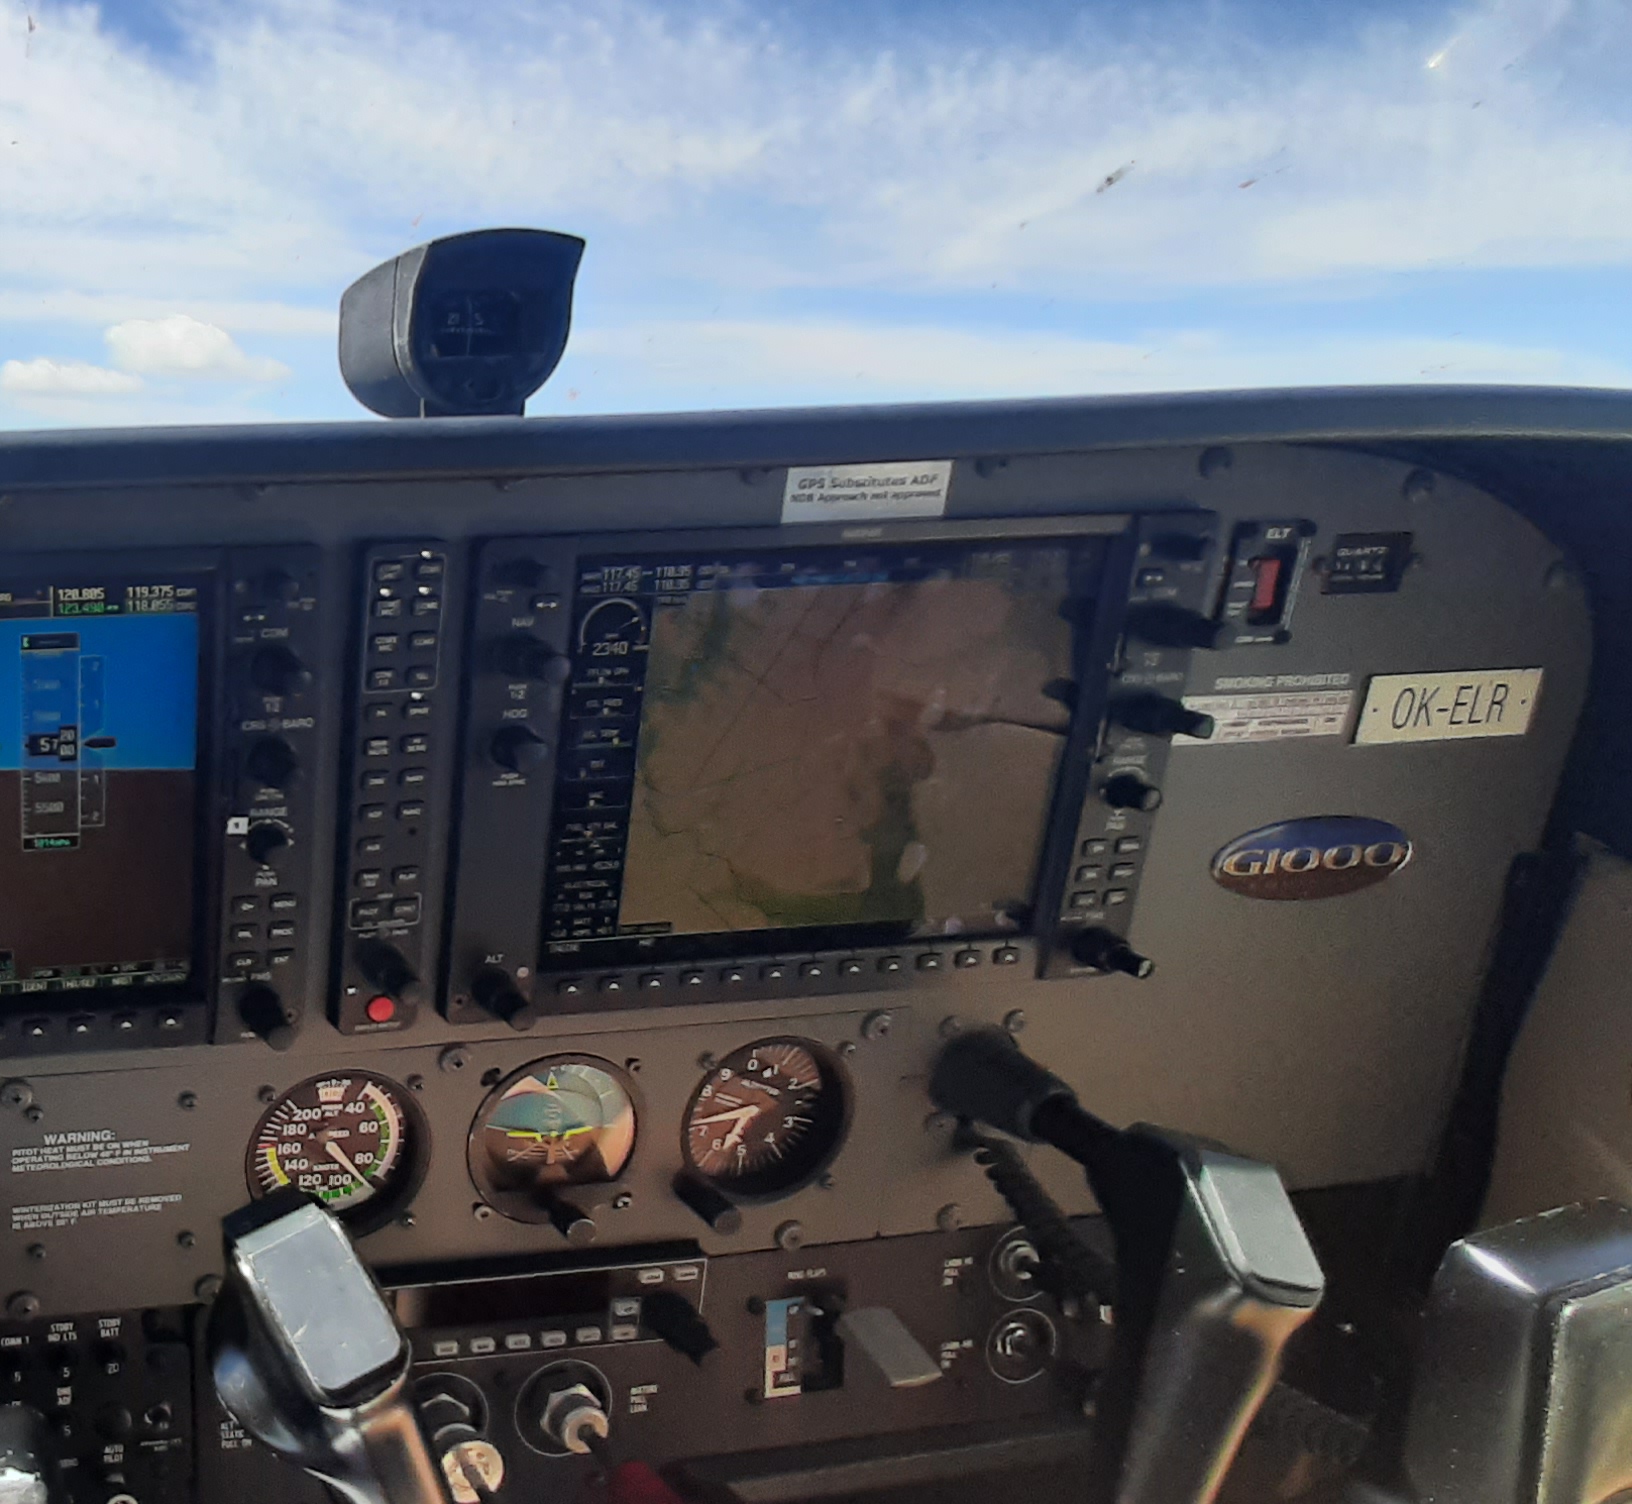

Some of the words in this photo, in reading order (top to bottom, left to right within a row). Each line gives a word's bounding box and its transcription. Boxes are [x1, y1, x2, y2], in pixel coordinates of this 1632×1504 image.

[798, 477, 825, 490] GPS
[830, 475, 907, 488] Substitutes
[910, 473, 939, 485] ADF
[512, 617, 535, 627] NAV
[593, 641, 629, 656] 2340
[1216, 675, 1273, 690] SMOKING
[1275, 672, 1351, 687] PROHIBITED
[1391, 684, 1509, 729] OK-ELR
[1223, 841, 1407, 877] G1000
[255, 876, 278, 887] PAN
[485, 954, 504, 965] ALT
[747, 1059, 759, 1072] 0
[720, 1068, 733, 1082] 9
[702, 1084, 714, 1098] 8
[292, 1107, 322, 1122] 200
[344, 1101, 365, 1115] 40
[282, 1123, 308, 1137] 180
[359, 1120, 379, 1134] 60
[44, 1130, 115, 1147] WARNING:
[712, 1138, 723, 1151] 6
[11, 1153, 64, 1165] OPERATING
[66, 1151, 97, 1162] BELOW
[134, 1144, 191, 1157] INSTRUMENT
[12, 1147, 38, 1157] PITOT
[40, 1145, 64, 1156] HEAT
[66, 1144, 91, 1154] MUST
[93, 1143, 105, 1152] BE
[107, 1142, 120, 1151] ON
[122, 1140, 150, 1150] WHEN
[277, 1143, 302, 1156] 160
[736, 1143, 748, 1157] 5
[354, 1152, 374, 1166] 80
[12, 1159, 95, 1174] METEOROLOGICAL
[284, 1163, 309, 1176] 140
[298, 1174, 322, 1187] 120
[329, 1173, 352, 1187] 100
[12, 1202, 80, 1215] WINTERIZATION
[82, 1200, 97, 1210] KIT
[99, 1198, 123, 1209] MUST
[125, 1197, 136, 1207] BE
[138, 1194, 183, 1206] REMOVED
[12, 1211, 40, 1223] WHEN
[42, 1208, 79, 1221] OUTSIDE
[81, 1207, 97, 1218] AIR
[99, 1203, 162, 1216] TEMPERATURE
[24, 1217, 54, 1229] ABOVE
